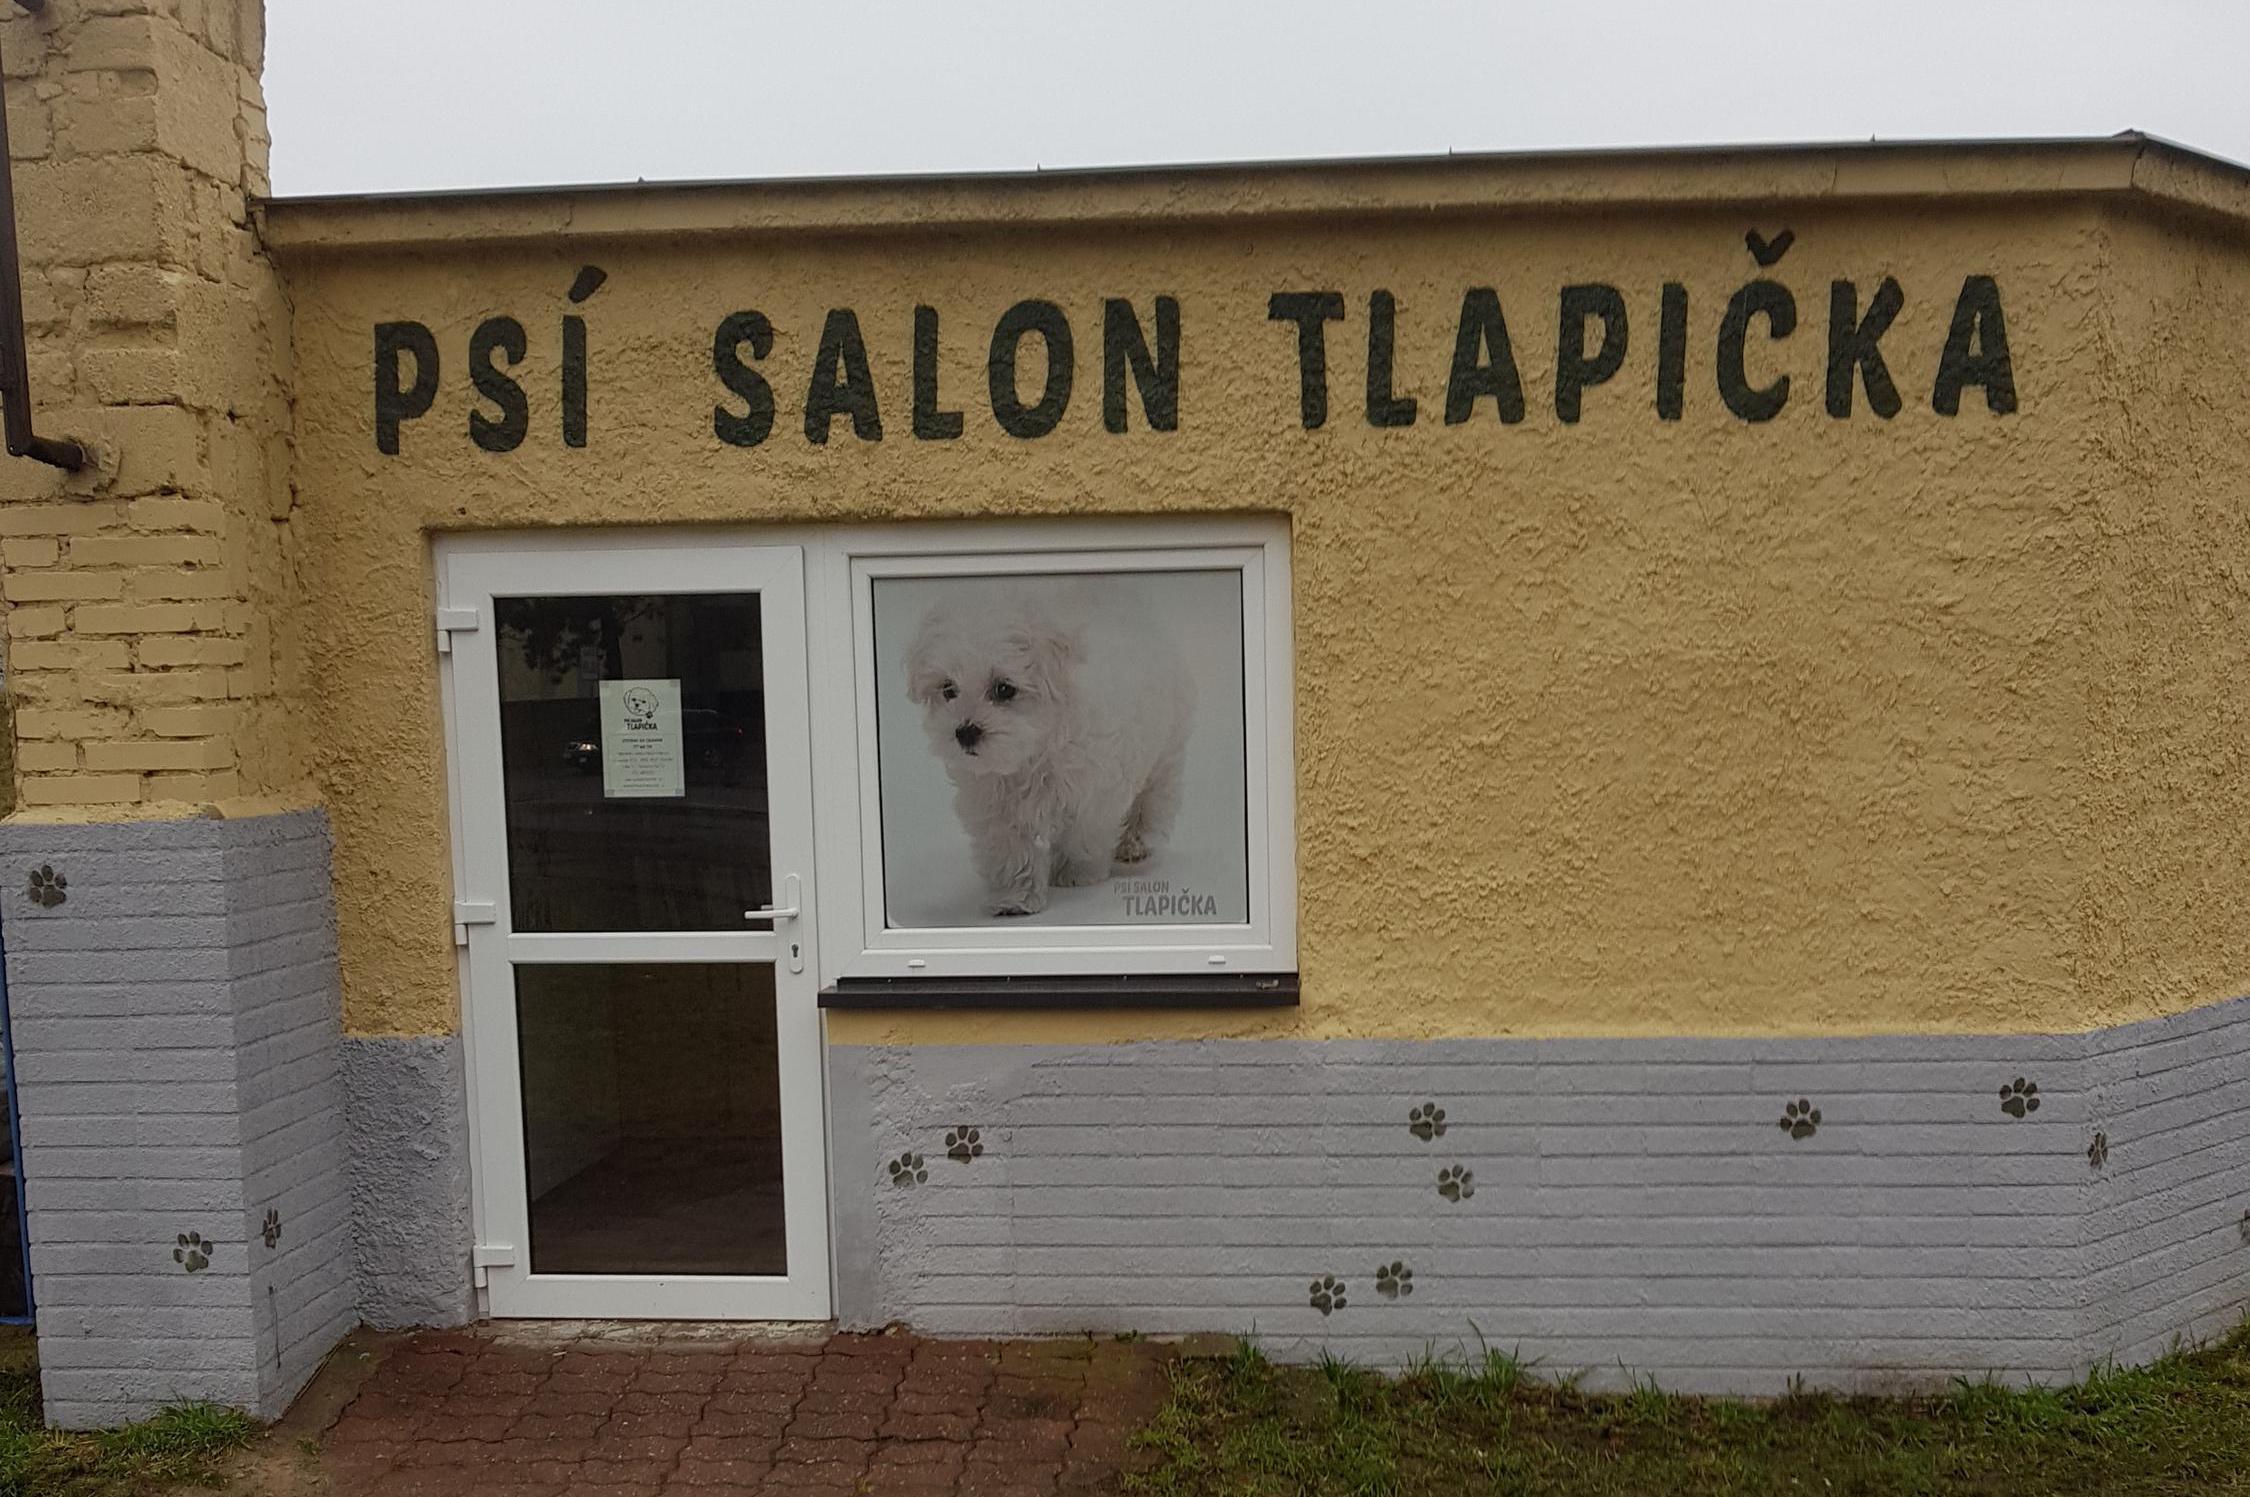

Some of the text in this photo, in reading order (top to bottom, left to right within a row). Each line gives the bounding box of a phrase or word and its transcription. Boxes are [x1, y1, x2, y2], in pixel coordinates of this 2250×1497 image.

[374, 228, 2019, 455] PSÍ SALON TLAPIČKA
[1134, 878, 1169, 893] SALON
[1123, 888, 1217, 916] TLAPIČKA
